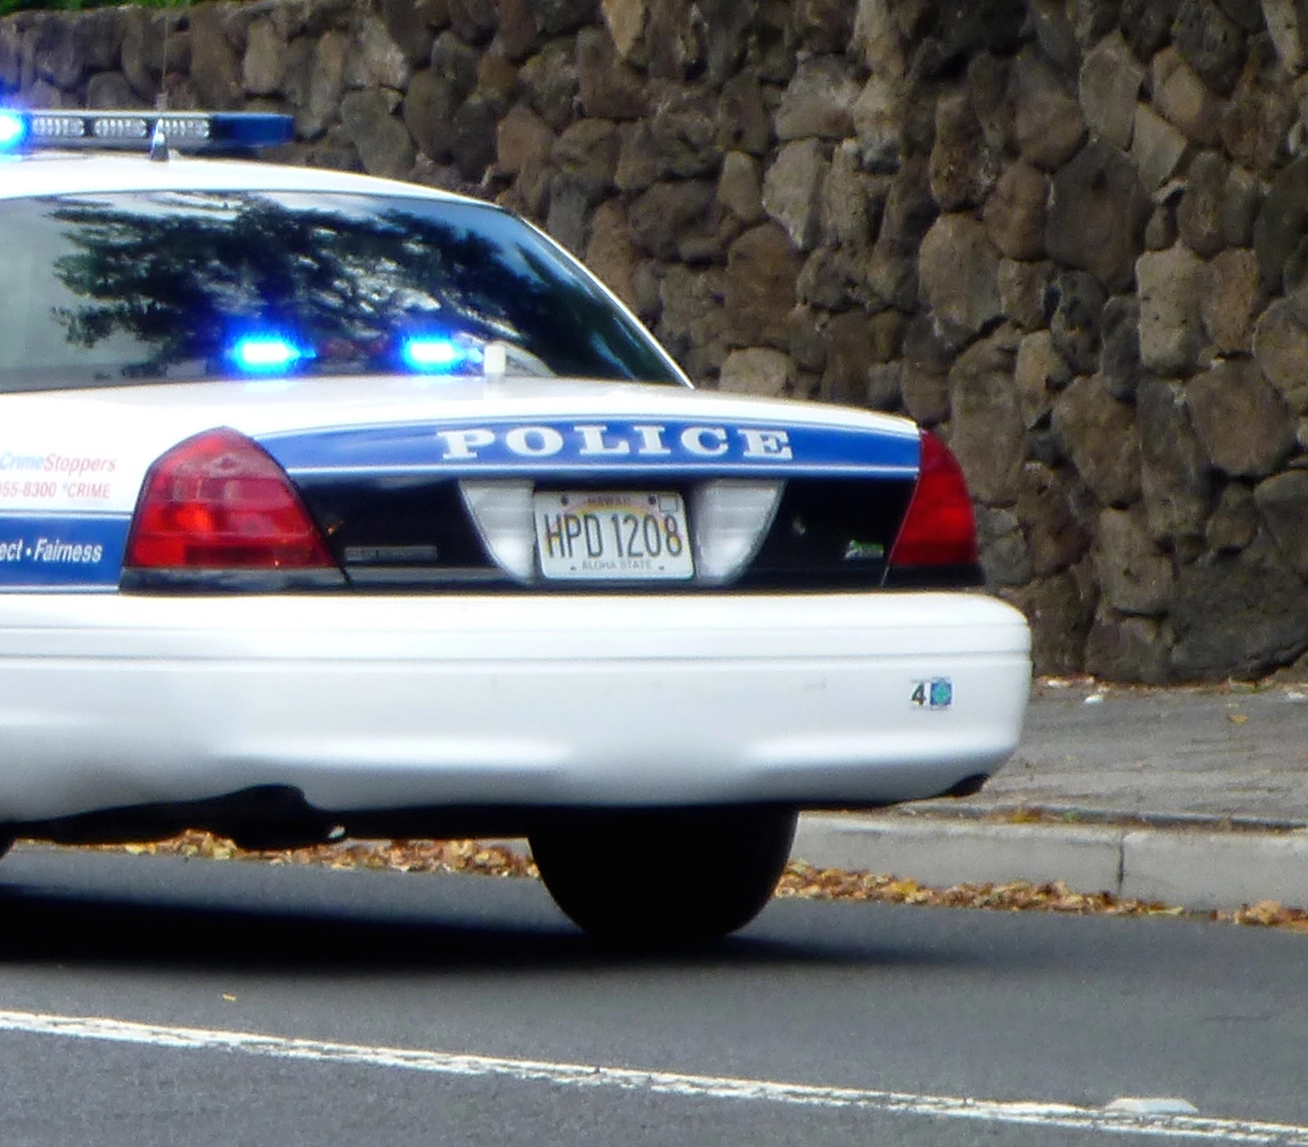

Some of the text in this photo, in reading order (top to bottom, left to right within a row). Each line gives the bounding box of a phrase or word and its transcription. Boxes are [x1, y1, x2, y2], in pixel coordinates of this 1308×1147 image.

[436, 424, 794, 461] POLICE
[0, 452, 117, 477] CrimeStoppers
[34, 538, 103, 563] Fairness
[544, 513, 682, 558] HPD 1208
